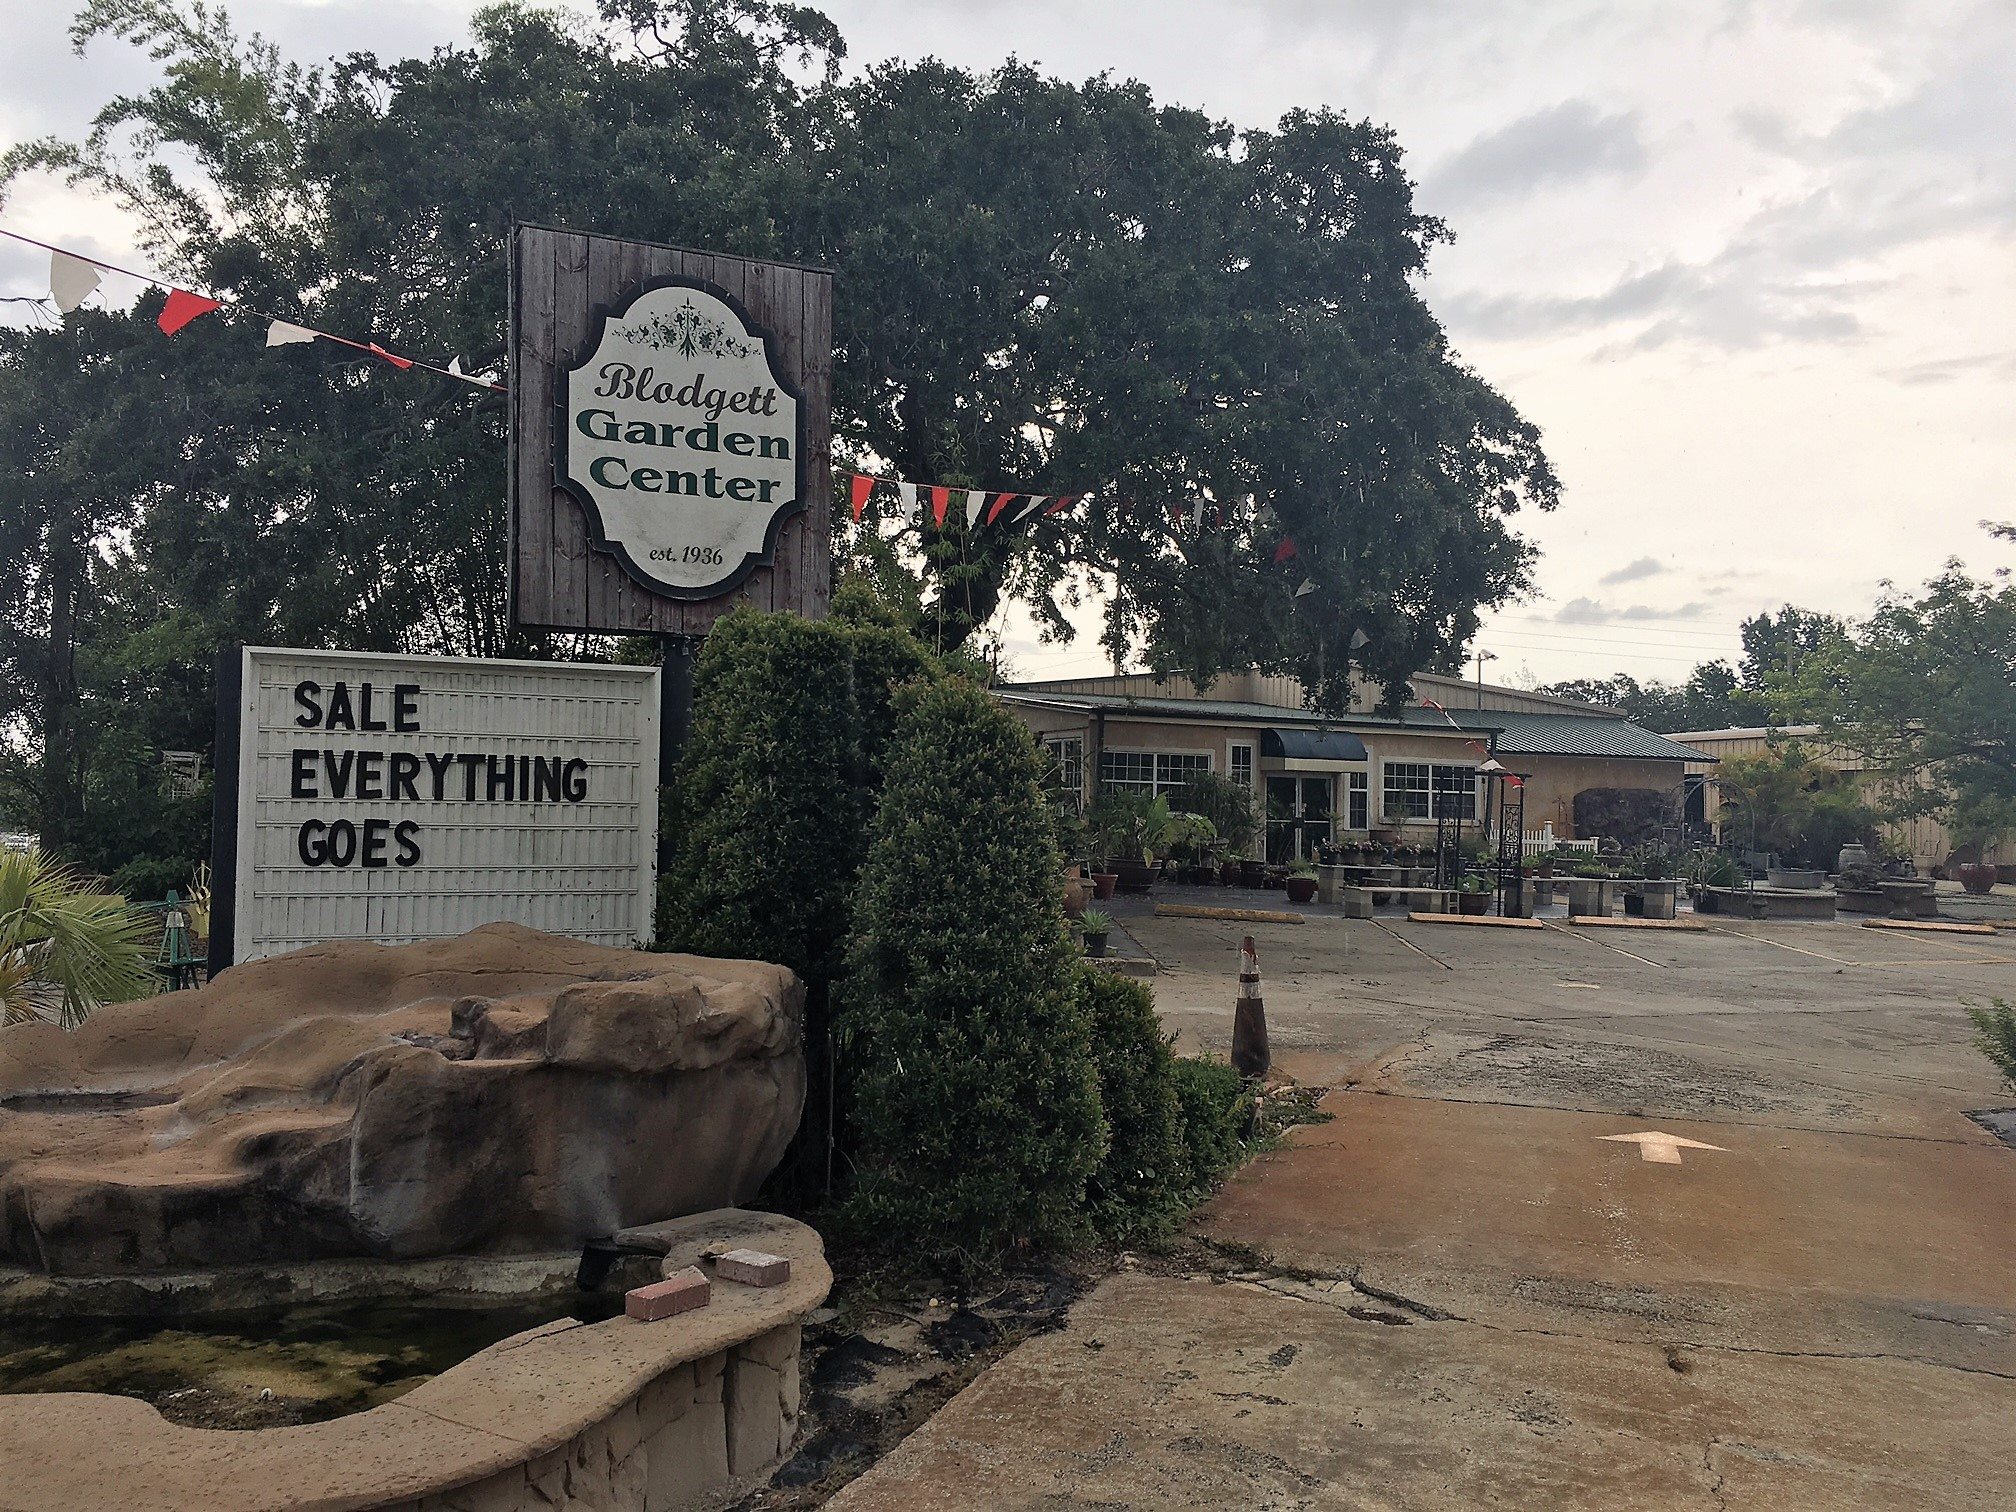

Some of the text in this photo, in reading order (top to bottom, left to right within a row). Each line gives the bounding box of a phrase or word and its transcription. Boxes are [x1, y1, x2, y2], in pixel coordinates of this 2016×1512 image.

[594, 362, 778, 420] Blodgett
[575, 408, 792, 460] Garden
[589, 456, 781, 503] Center
[649, 545, 723, 566] est. 1936
[294, 680, 421, 732] SALE
[291, 748, 589, 803] EVERYTHING
[297, 818, 421, 867] GOES
